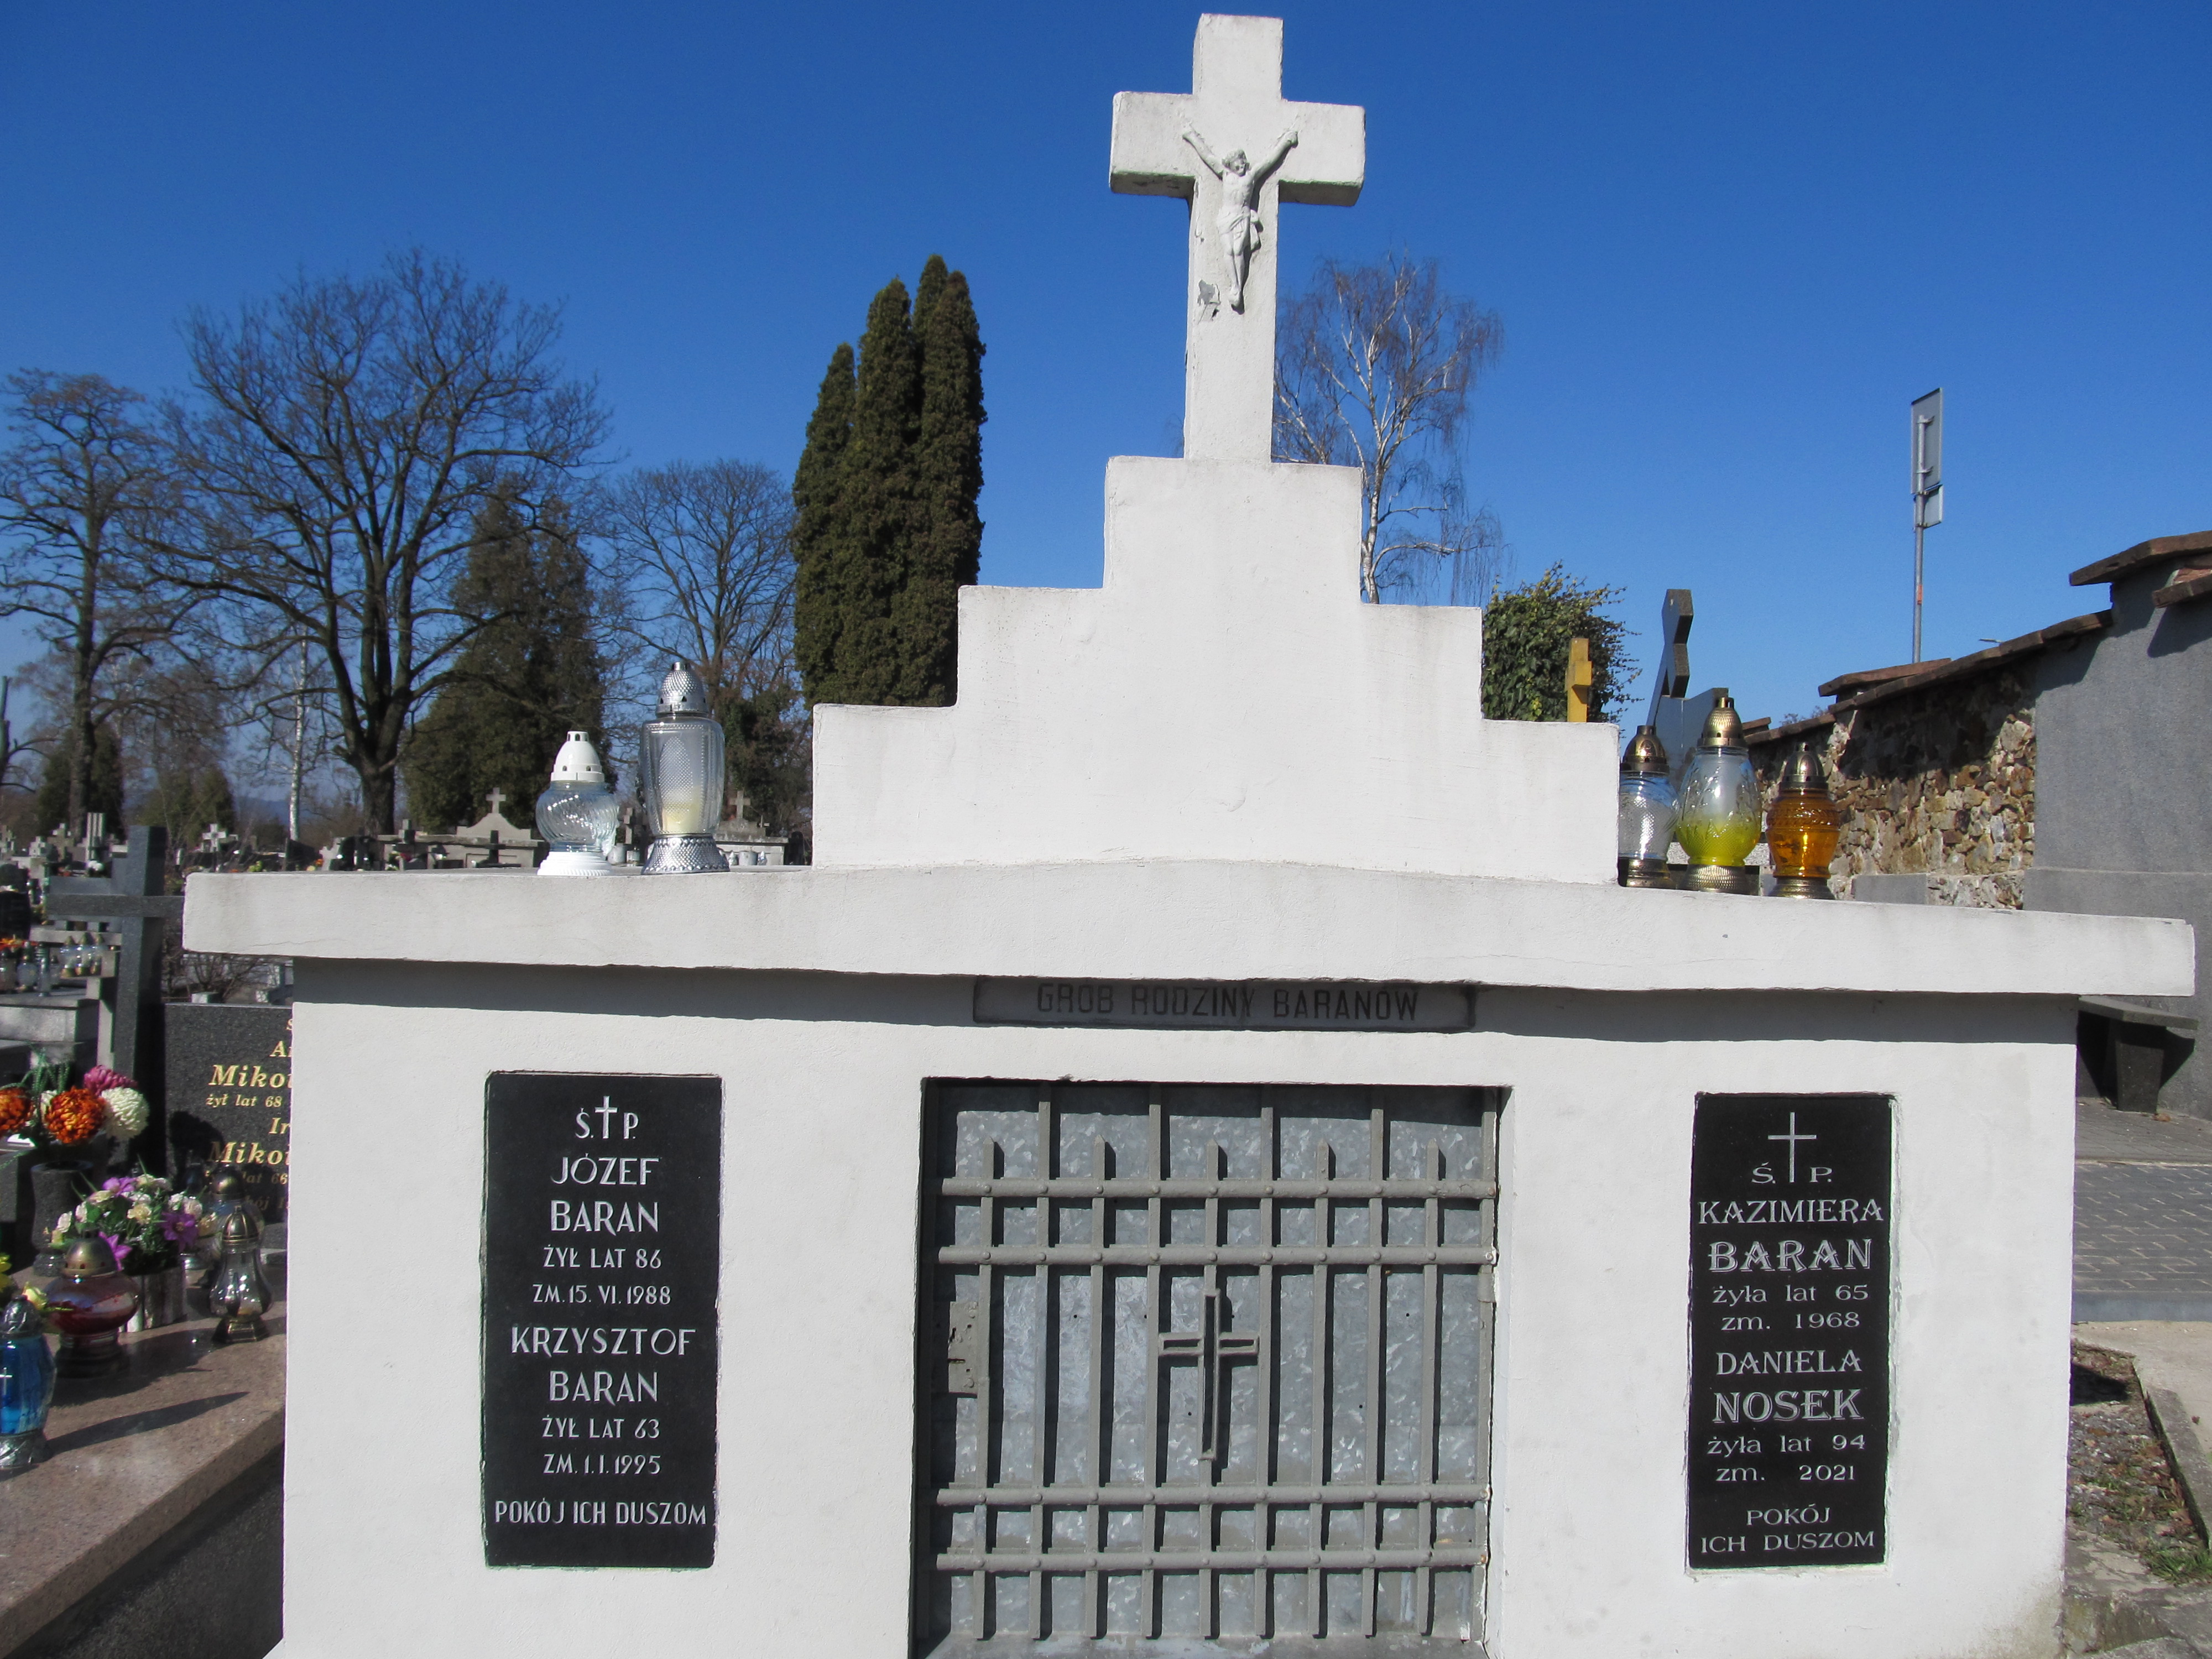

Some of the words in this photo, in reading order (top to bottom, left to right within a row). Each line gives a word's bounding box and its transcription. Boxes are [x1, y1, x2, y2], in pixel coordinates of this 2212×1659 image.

[1131, 984, 1255, 1016] RODZINY
[206, 1093, 229, 1108] żył
[236, 1094, 258, 1107] lat
[265, 1095, 283, 1107] 68
[551, 1153, 659, 1185] JÓZEF
[551, 1200, 658, 1236] BARAN
[1699, 1199, 1884, 1224] KAZIMIERA
[544, 1244, 580, 1267] ŻYŁ
[591, 1248, 626, 1267] LAT
[636, 1249, 661, 1269] 86
[1708, 1239, 1871, 1272] BARAN
[1713, 1285, 1767, 1305] żyła
[1786, 1285, 1816, 1301] lat
[1835, 1285, 1868, 1300] 65
[1721, 1317, 1770, 1330] zm.
[1796, 1312, 1859, 1328] 1968
[512, 1327, 696, 1357] KRZYSZTOF
[1717, 1350, 1862, 1375] DANIELA
[550, 1371, 657, 1406] BARAN
[1712, 1389, 1864, 1423] NOSEK
[542, 1418, 579, 1438] ŻYŁ
[589, 1418, 624, 1438] LAT
[635, 1419, 659, 1438] 63
[1708, 1436, 1761, 1455] żyła
[1781, 1436, 1811, 1452] lat
[1833, 1434, 1865, 1450] 94
[1716, 1468, 1764, 1481] zm.
[1799, 1465, 1854, 1480] 2021
[495, 1498, 564, 1524] POKÓJ
[573, 1501, 605, 1525] ICH
[616, 1502, 706, 1524] DUSZOM
[1747, 1504, 1830, 1525] POKÓJ
[1702, 1536, 1745, 1553] ICH
[1764, 1531, 1874, 1550] DUSZOM
